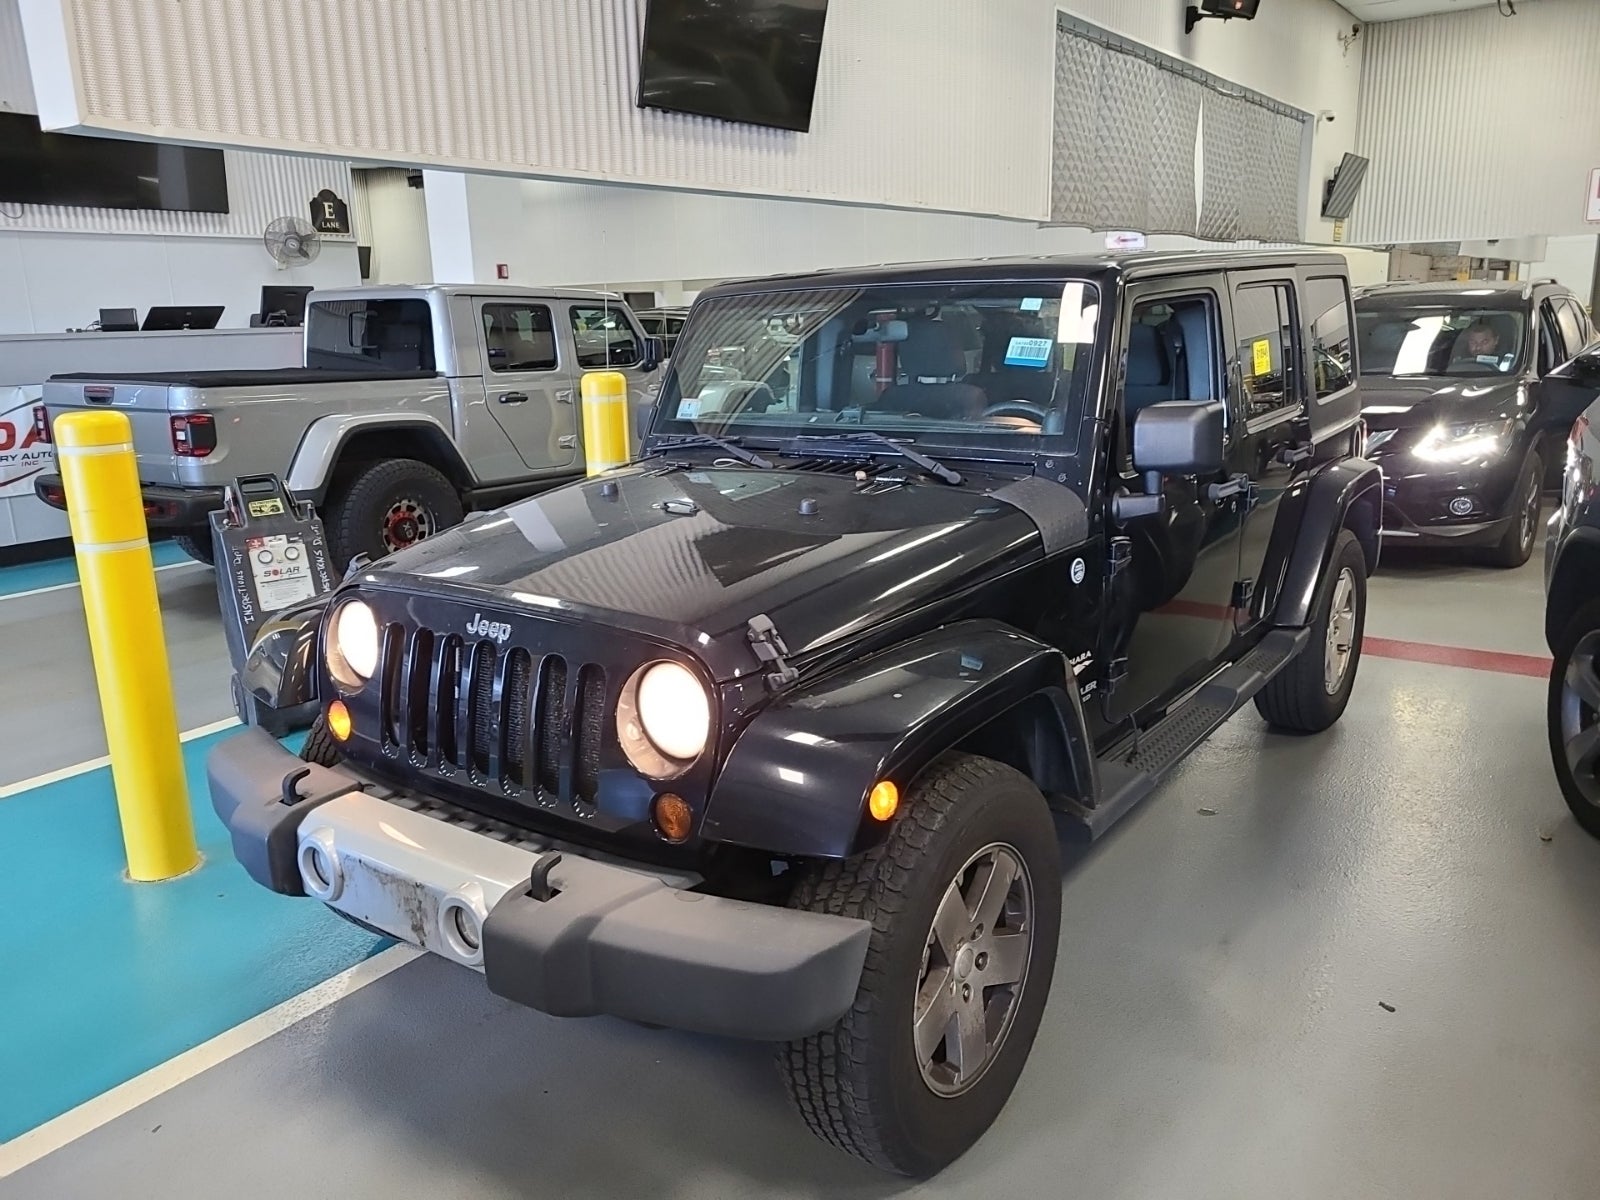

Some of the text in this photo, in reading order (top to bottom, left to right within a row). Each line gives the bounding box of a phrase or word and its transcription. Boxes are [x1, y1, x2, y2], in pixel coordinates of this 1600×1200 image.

[323, 202, 335, 218] E
[321, 221, 340, 229] LANE
[263, 566, 300, 577] SOLAR
[466, 612, 512, 644] Jeep
